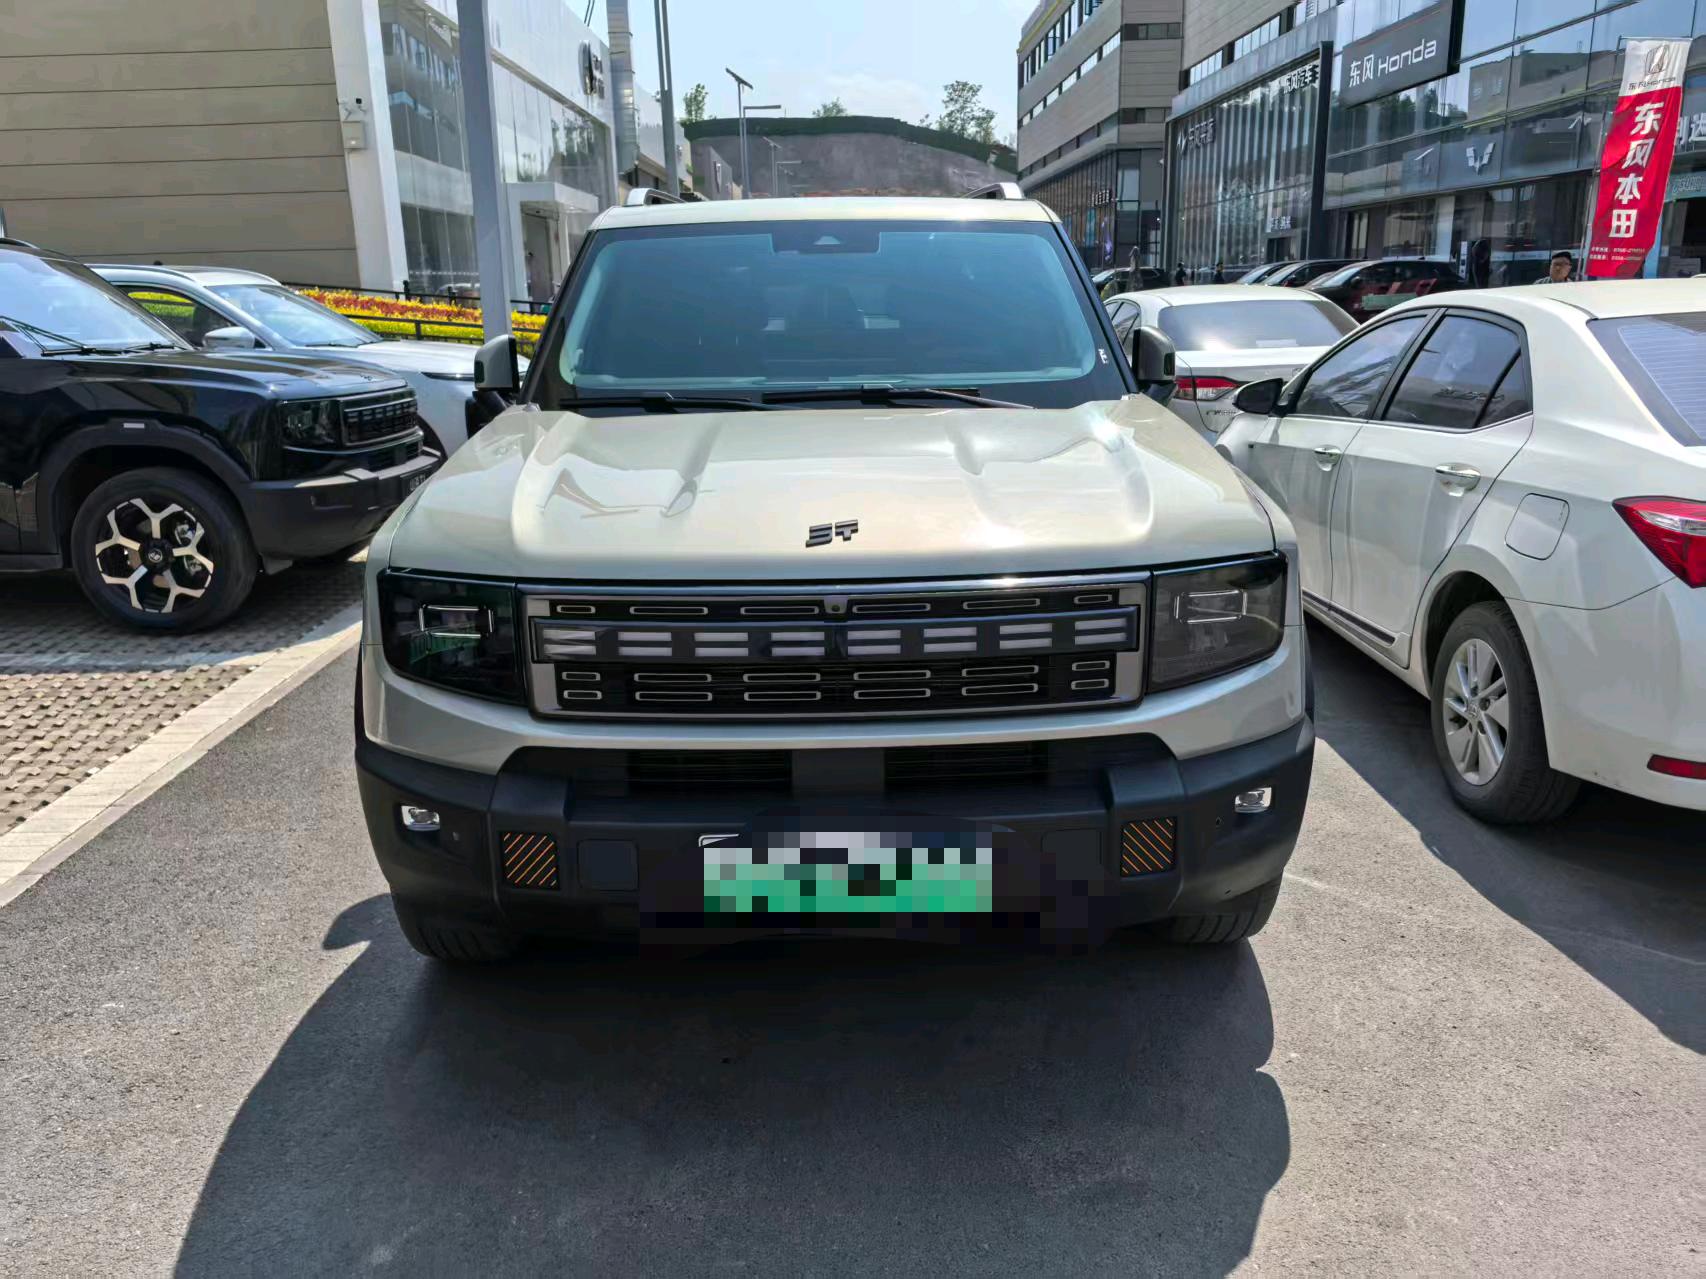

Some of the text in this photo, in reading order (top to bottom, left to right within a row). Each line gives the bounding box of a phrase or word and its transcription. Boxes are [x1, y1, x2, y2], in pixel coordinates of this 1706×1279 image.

[1349, 38, 1437, 88] 东风 Honda
[1609, 102, 1664, 238] 东风本田
